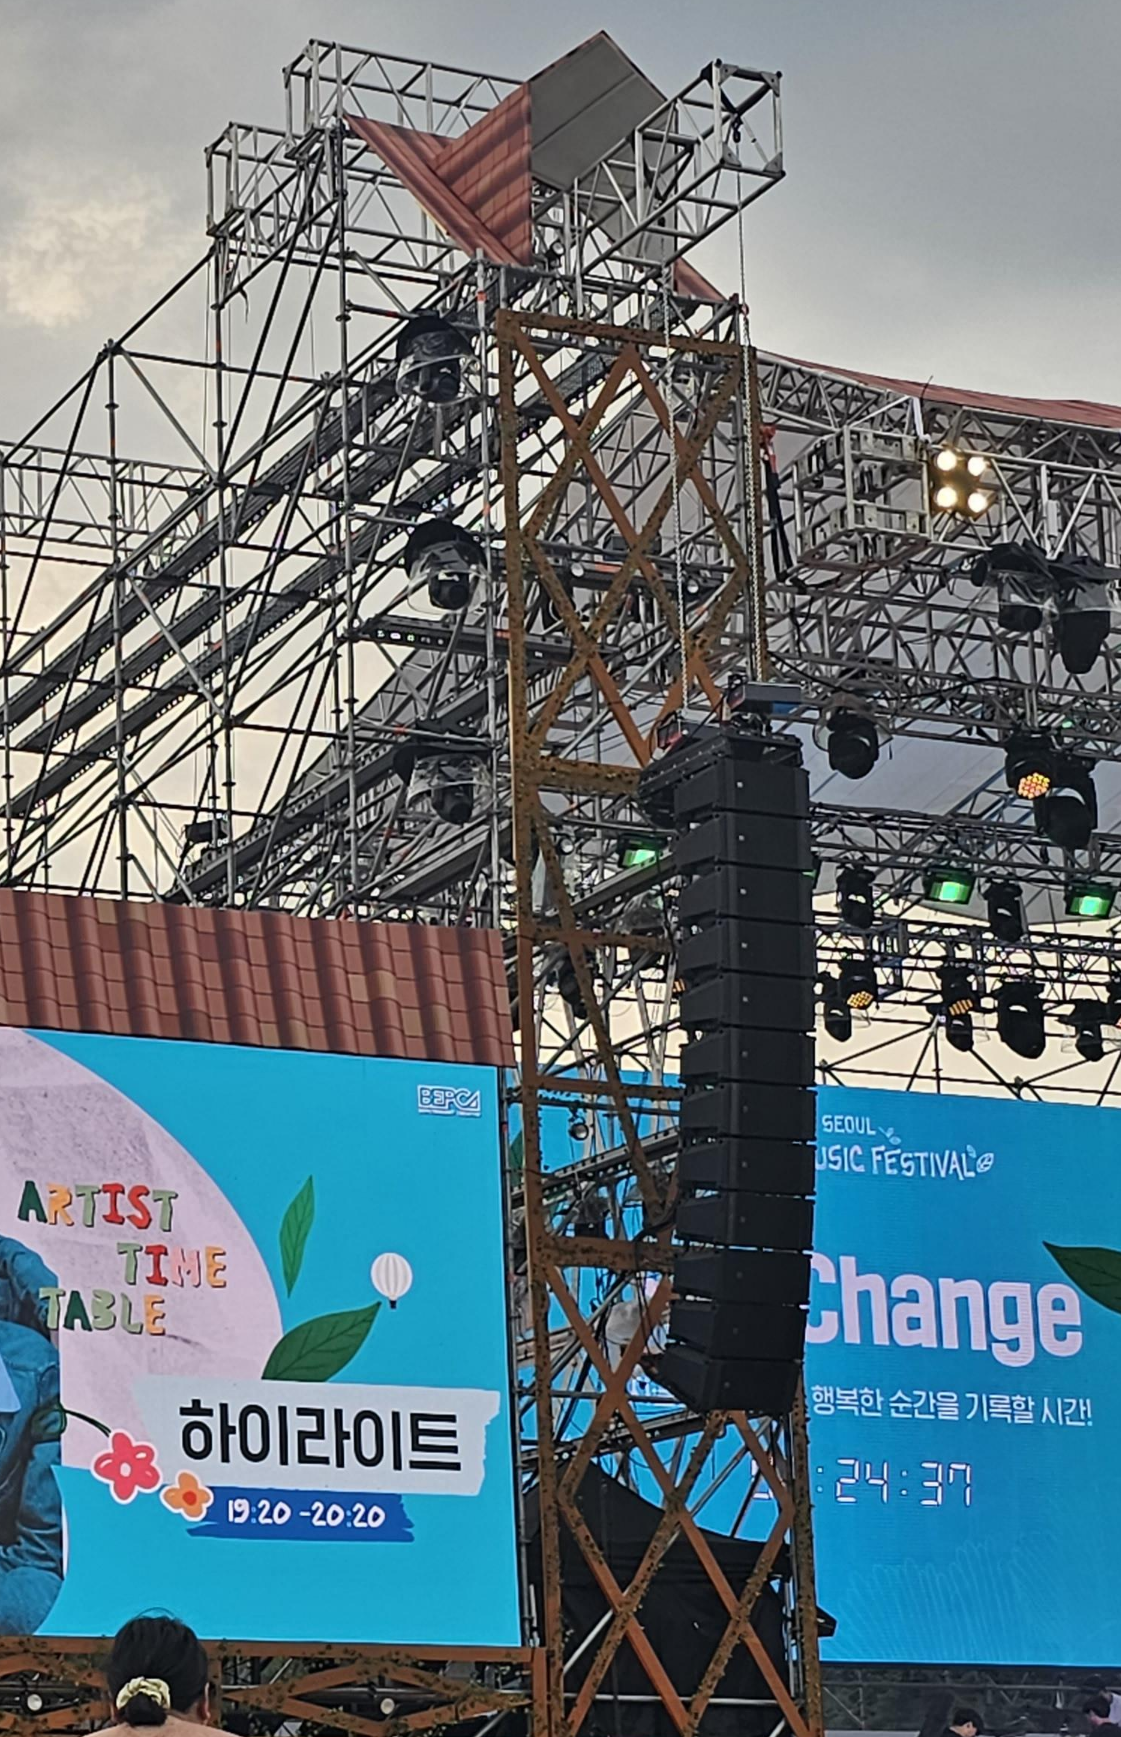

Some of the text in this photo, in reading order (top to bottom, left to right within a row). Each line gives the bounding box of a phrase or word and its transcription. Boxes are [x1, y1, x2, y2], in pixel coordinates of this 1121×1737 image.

[822, 1114, 877, 1136] SEOUL
[815, 1144, 976, 1181] USIC FESTIVAL
[17, 1180, 178, 1231] ARTIST
[116, 1242, 227, 1288] TIME
[39, 1287, 166, 1335] TABLE
[804, 1250, 1083, 1367] Change
[811, 1385, 1093, 1427] 행복한 순간을 기록할 시간!
[179, 1399, 461, 1471] 하이라이트
